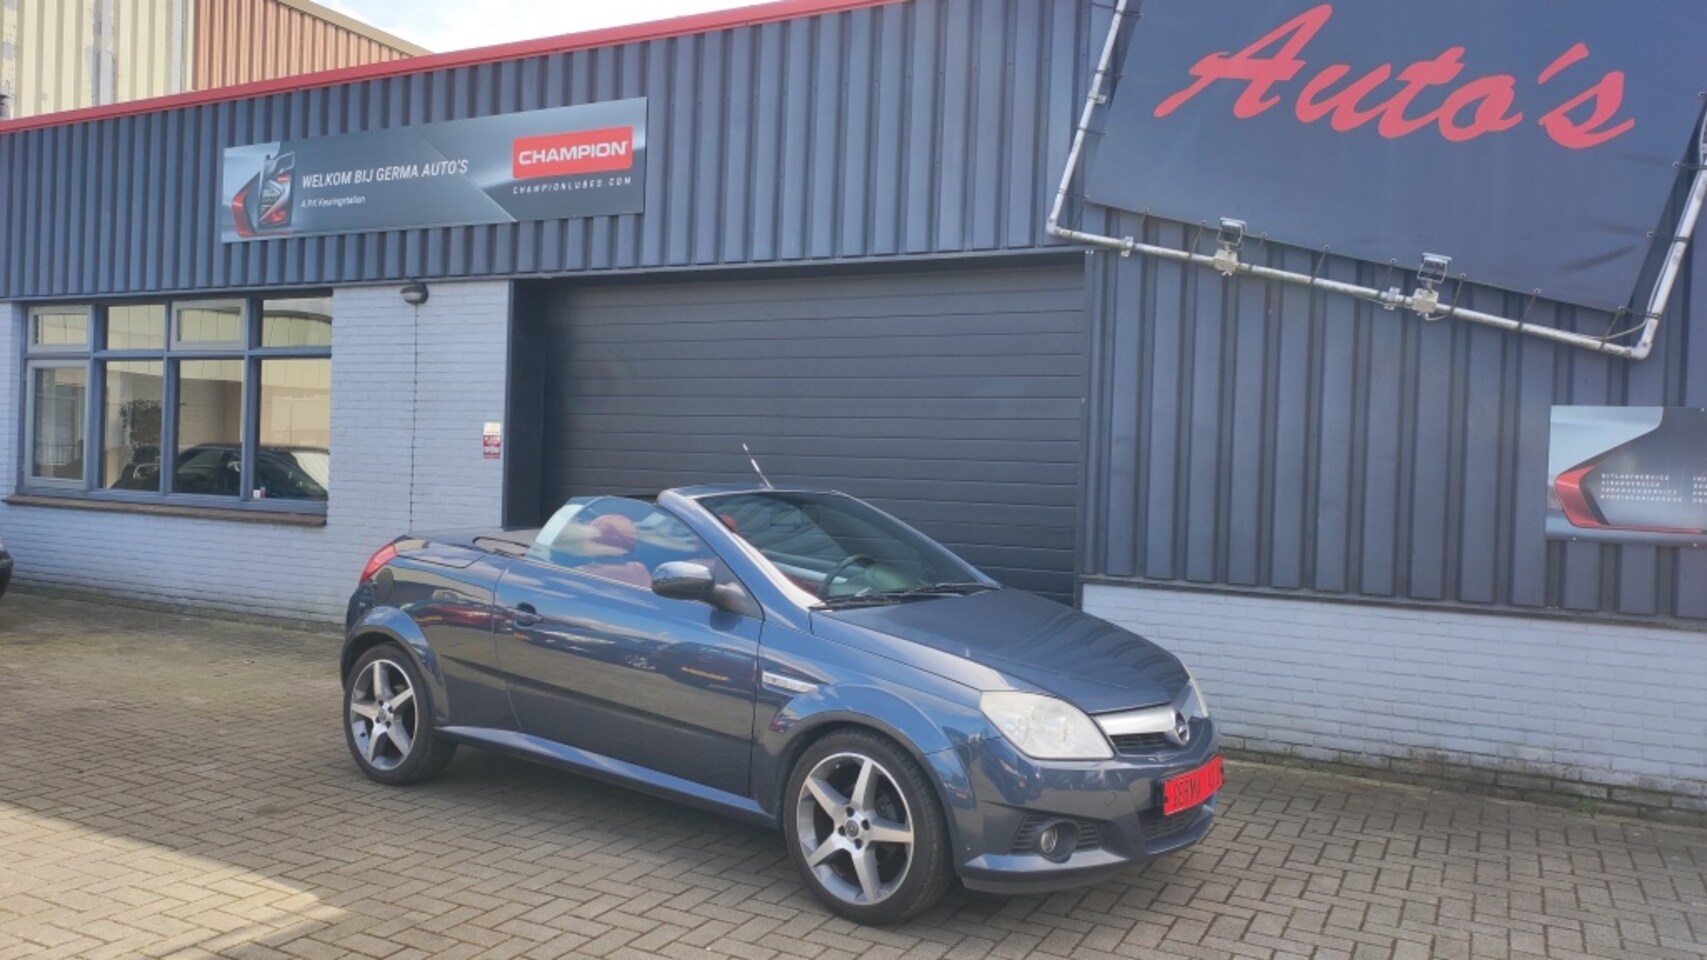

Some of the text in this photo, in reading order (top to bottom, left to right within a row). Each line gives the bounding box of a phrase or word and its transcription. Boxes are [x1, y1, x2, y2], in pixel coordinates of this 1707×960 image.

[1153, 3, 1635, 149] Auto's
[518, 141, 629, 165] CHAMPION
[302, 159, 469, 189] WELKOM BIJ GERMA AUTO'S
[512, 177, 631, 194] CHAMPIONLUBES.COM
